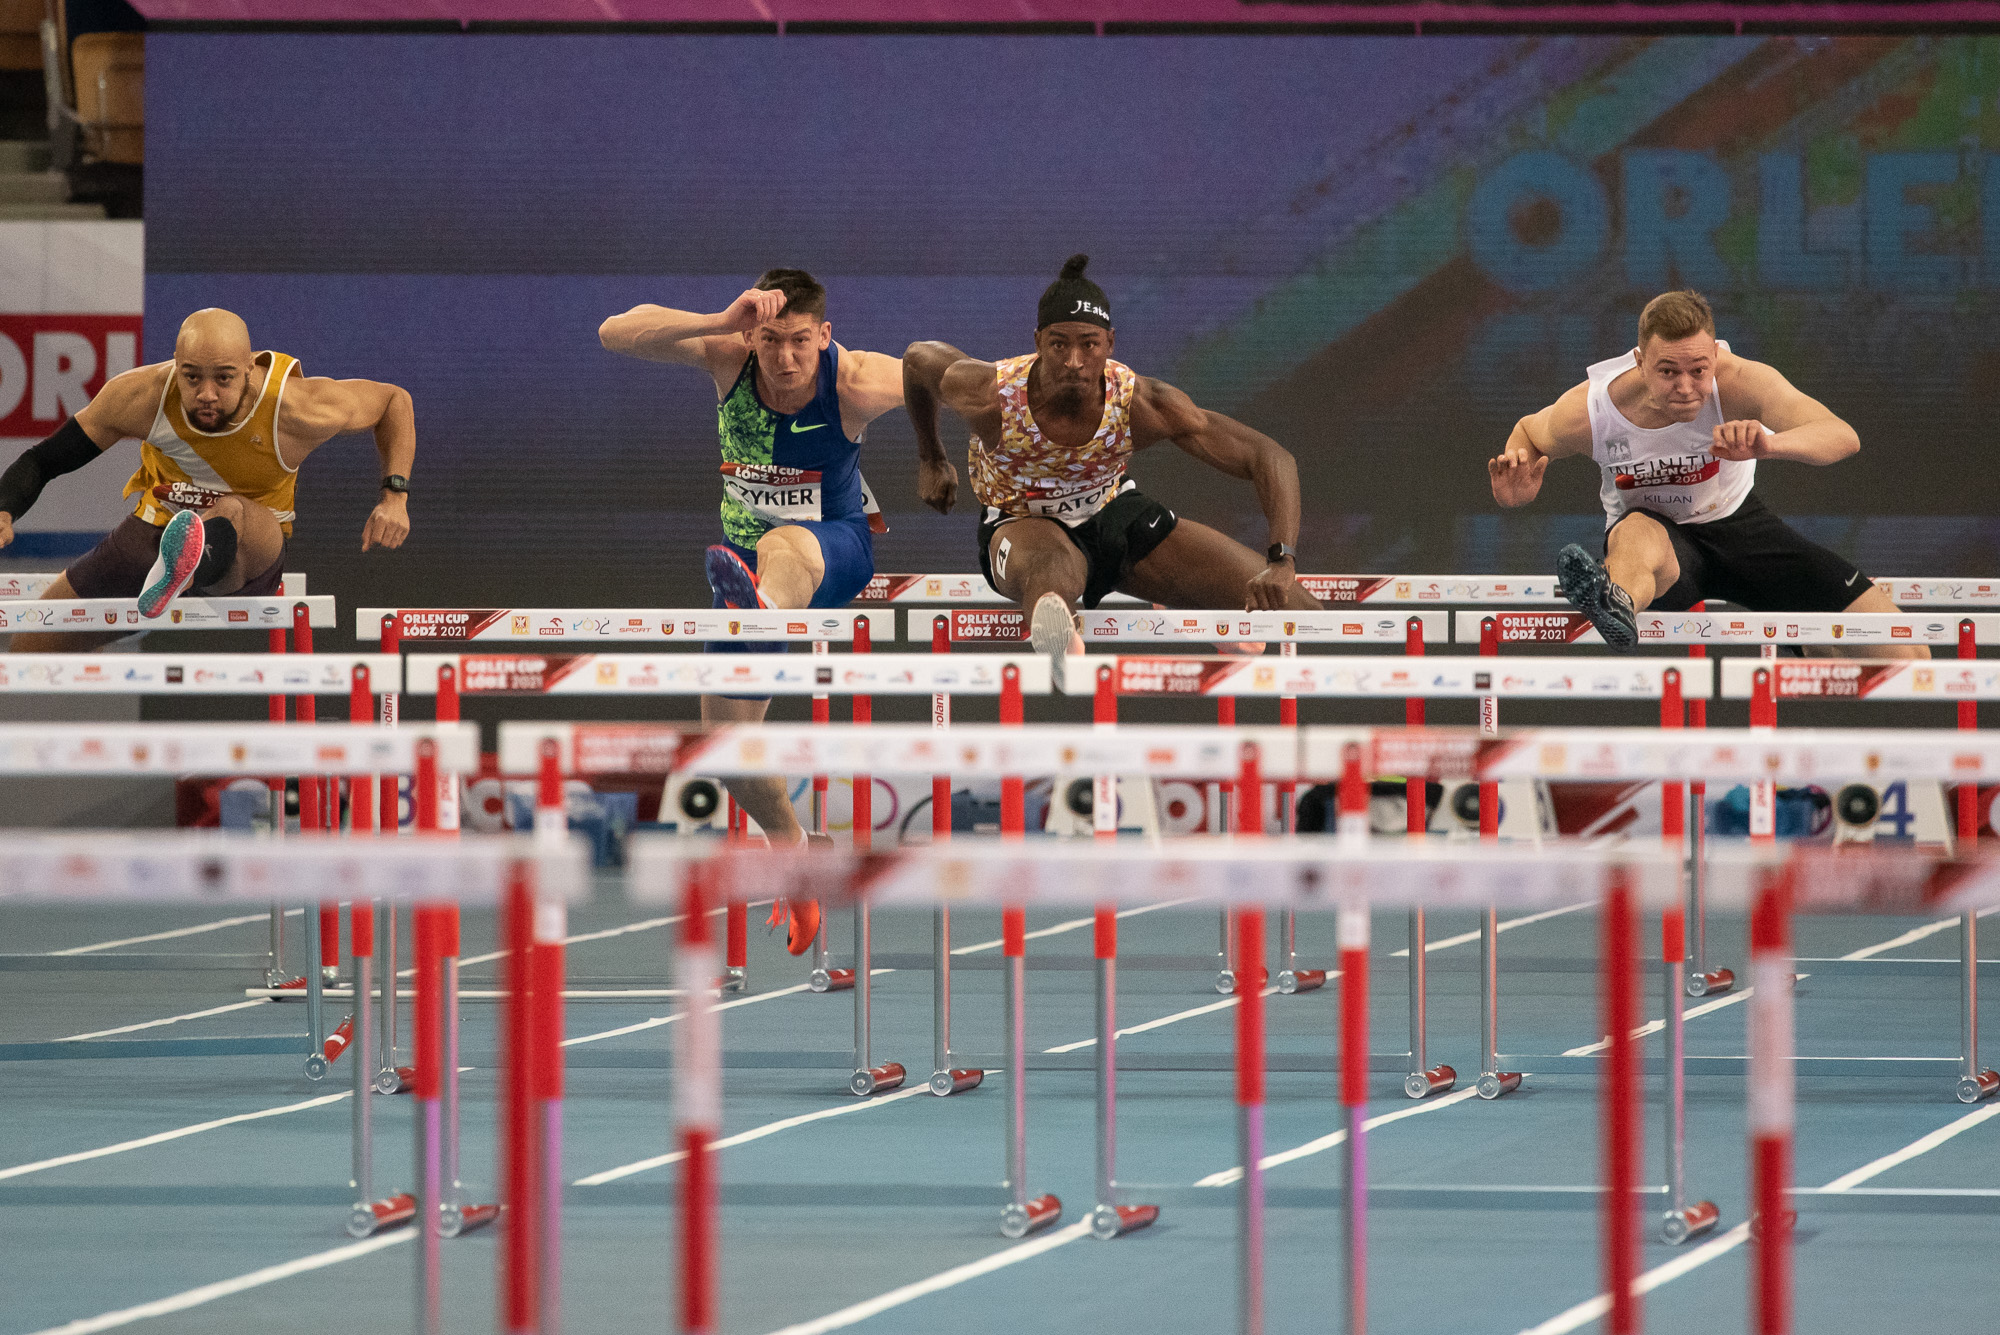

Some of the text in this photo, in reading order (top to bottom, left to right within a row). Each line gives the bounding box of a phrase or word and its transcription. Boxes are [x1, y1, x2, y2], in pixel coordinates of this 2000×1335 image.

[1467, 147, 2000, 291] ORLE
[773, 476, 800, 485] 2021
[1675, 473, 1702, 484] 2021
[1041, 479, 1115, 514] EATON
[1644, 494, 1692, 504] KILJAN
[1338, 580, 1360, 590] CUP
[865, 589, 888, 598] 2021
[1334, 591, 1357, 600] 2021
[403, 614, 469, 624] ORLEN CUP
[958, 614, 1024, 624] ORLEN CUP
[1503, 617, 1569, 627] ORLEN CUP
[403, 624, 465, 636] ŁÓDŹ 2021
[958, 624, 1020, 636] ŁÓDŹ 2021
[1503, 627, 1565, 639] ŁÓDŹ 2021
[1879, 780, 1914, 837] 4
